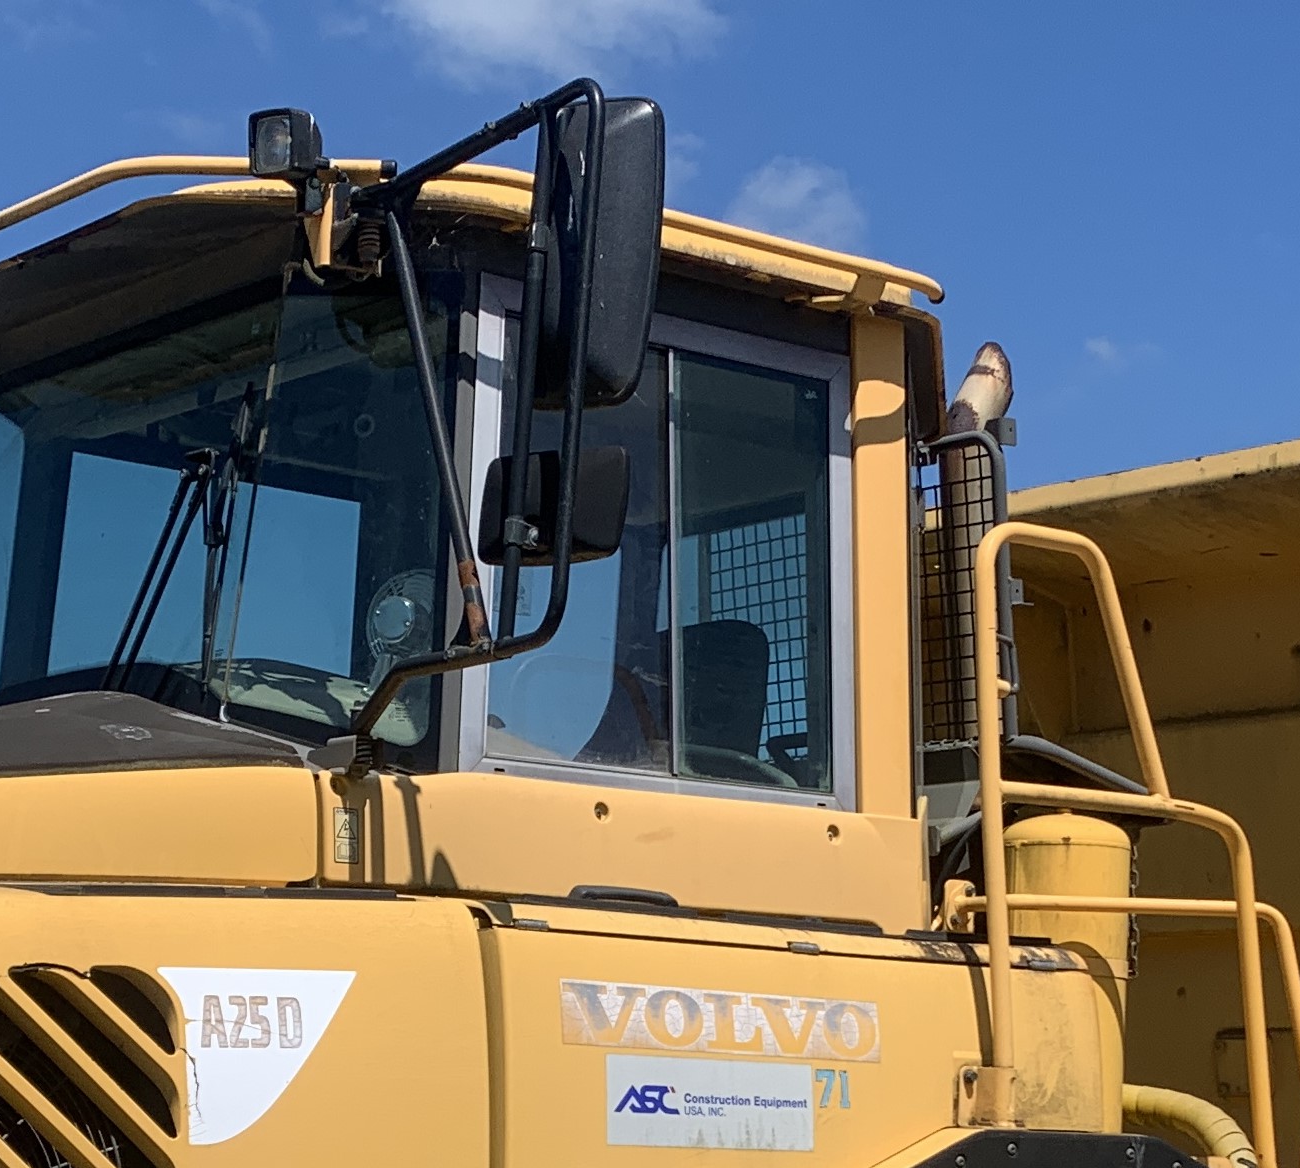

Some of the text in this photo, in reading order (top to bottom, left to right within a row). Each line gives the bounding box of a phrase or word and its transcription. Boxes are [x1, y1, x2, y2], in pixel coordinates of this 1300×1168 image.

[561, 981, 877, 1059] VOLVO
[614, 1084, 681, 1115] ASC
[683, 1093, 808, 1110] Construction Equipment
[815, 1068, 851, 1109] 71
[683, 1105, 727, 1118] USA, INC.
